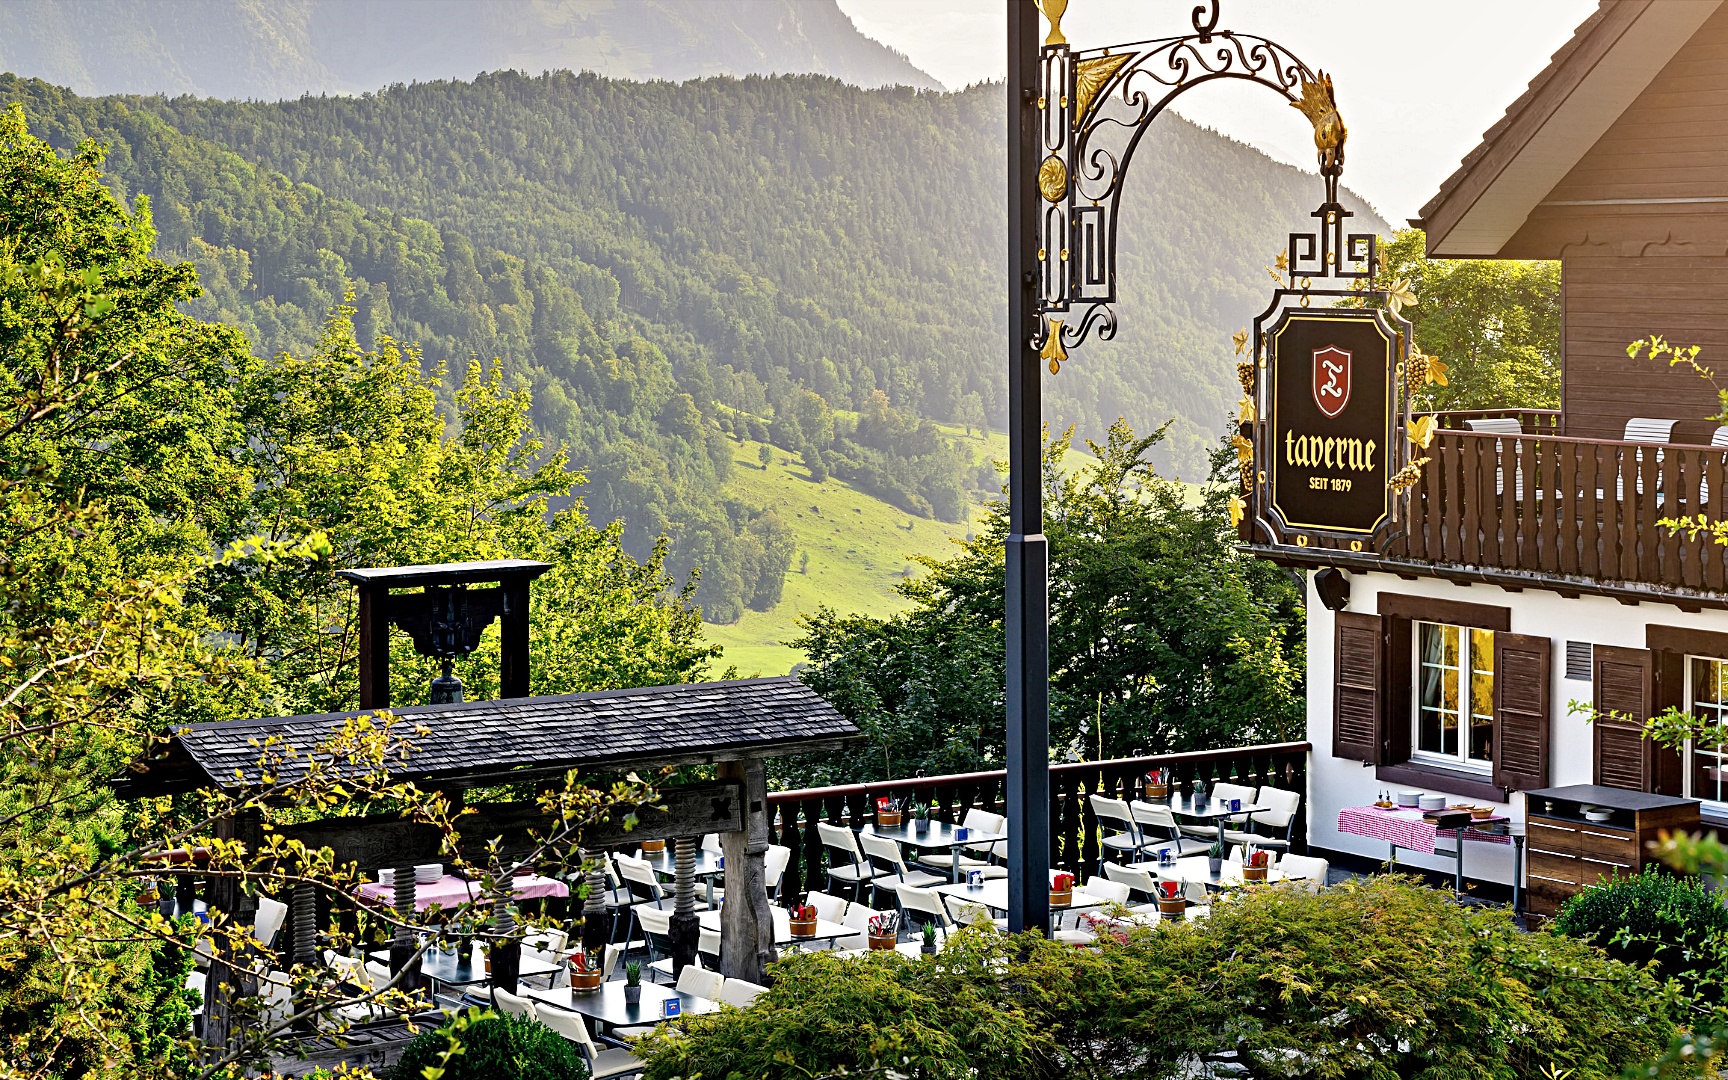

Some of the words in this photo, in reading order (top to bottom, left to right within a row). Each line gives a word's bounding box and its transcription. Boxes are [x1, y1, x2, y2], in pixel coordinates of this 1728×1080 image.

[1285, 429, 1377, 472] taverne
[1309, 476, 1329, 490] SEIT
[1330, 478, 1352, 492] 1879
